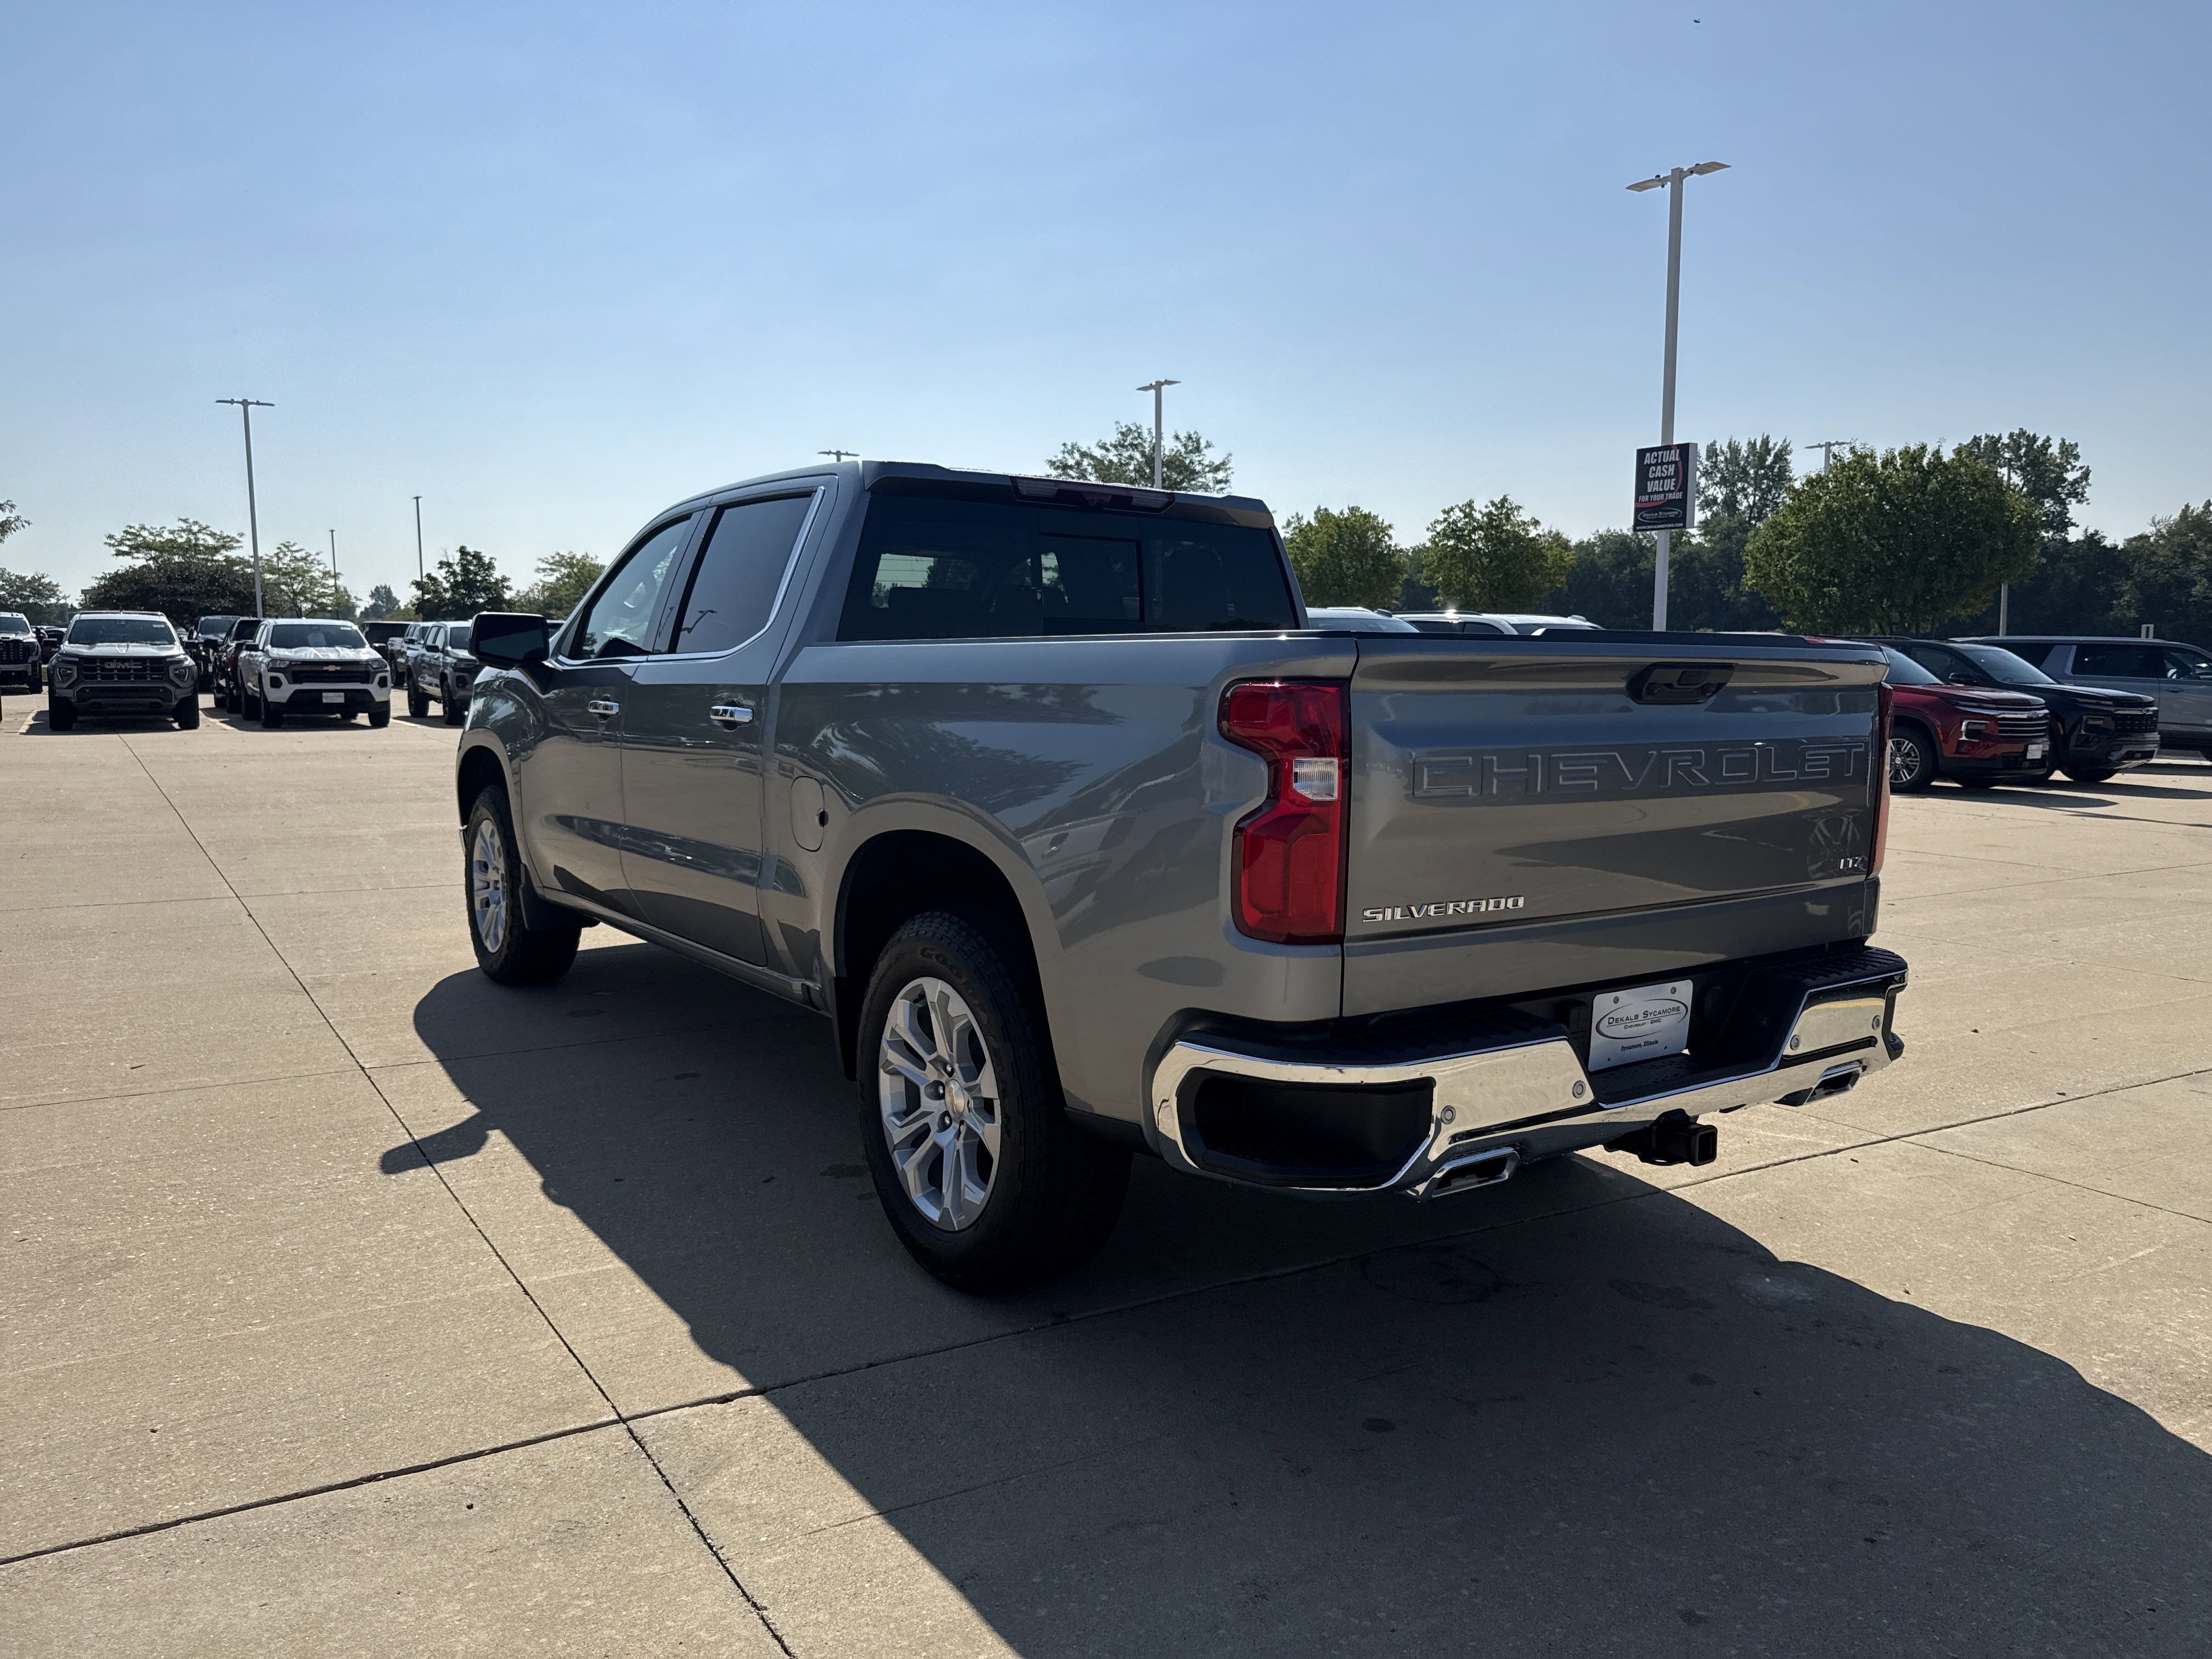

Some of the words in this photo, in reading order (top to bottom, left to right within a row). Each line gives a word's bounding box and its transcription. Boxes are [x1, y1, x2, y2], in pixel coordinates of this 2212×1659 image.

[1644, 449, 1680, 465] ACTUAL
[1649, 464, 1675, 478] CASH
[1647, 478, 1676, 493] VALUE
[1650, 493, 1664, 501] YOUR
[1665, 492, 1683, 500] TRADE
[1413, 742, 1865, 799] CHEVROLET
[1362, 895, 1525, 922] SILVERADO
[1608, 1014, 1639, 1025] DEKALB
[1643, 1006, 1680, 1019] SYCAMORE
